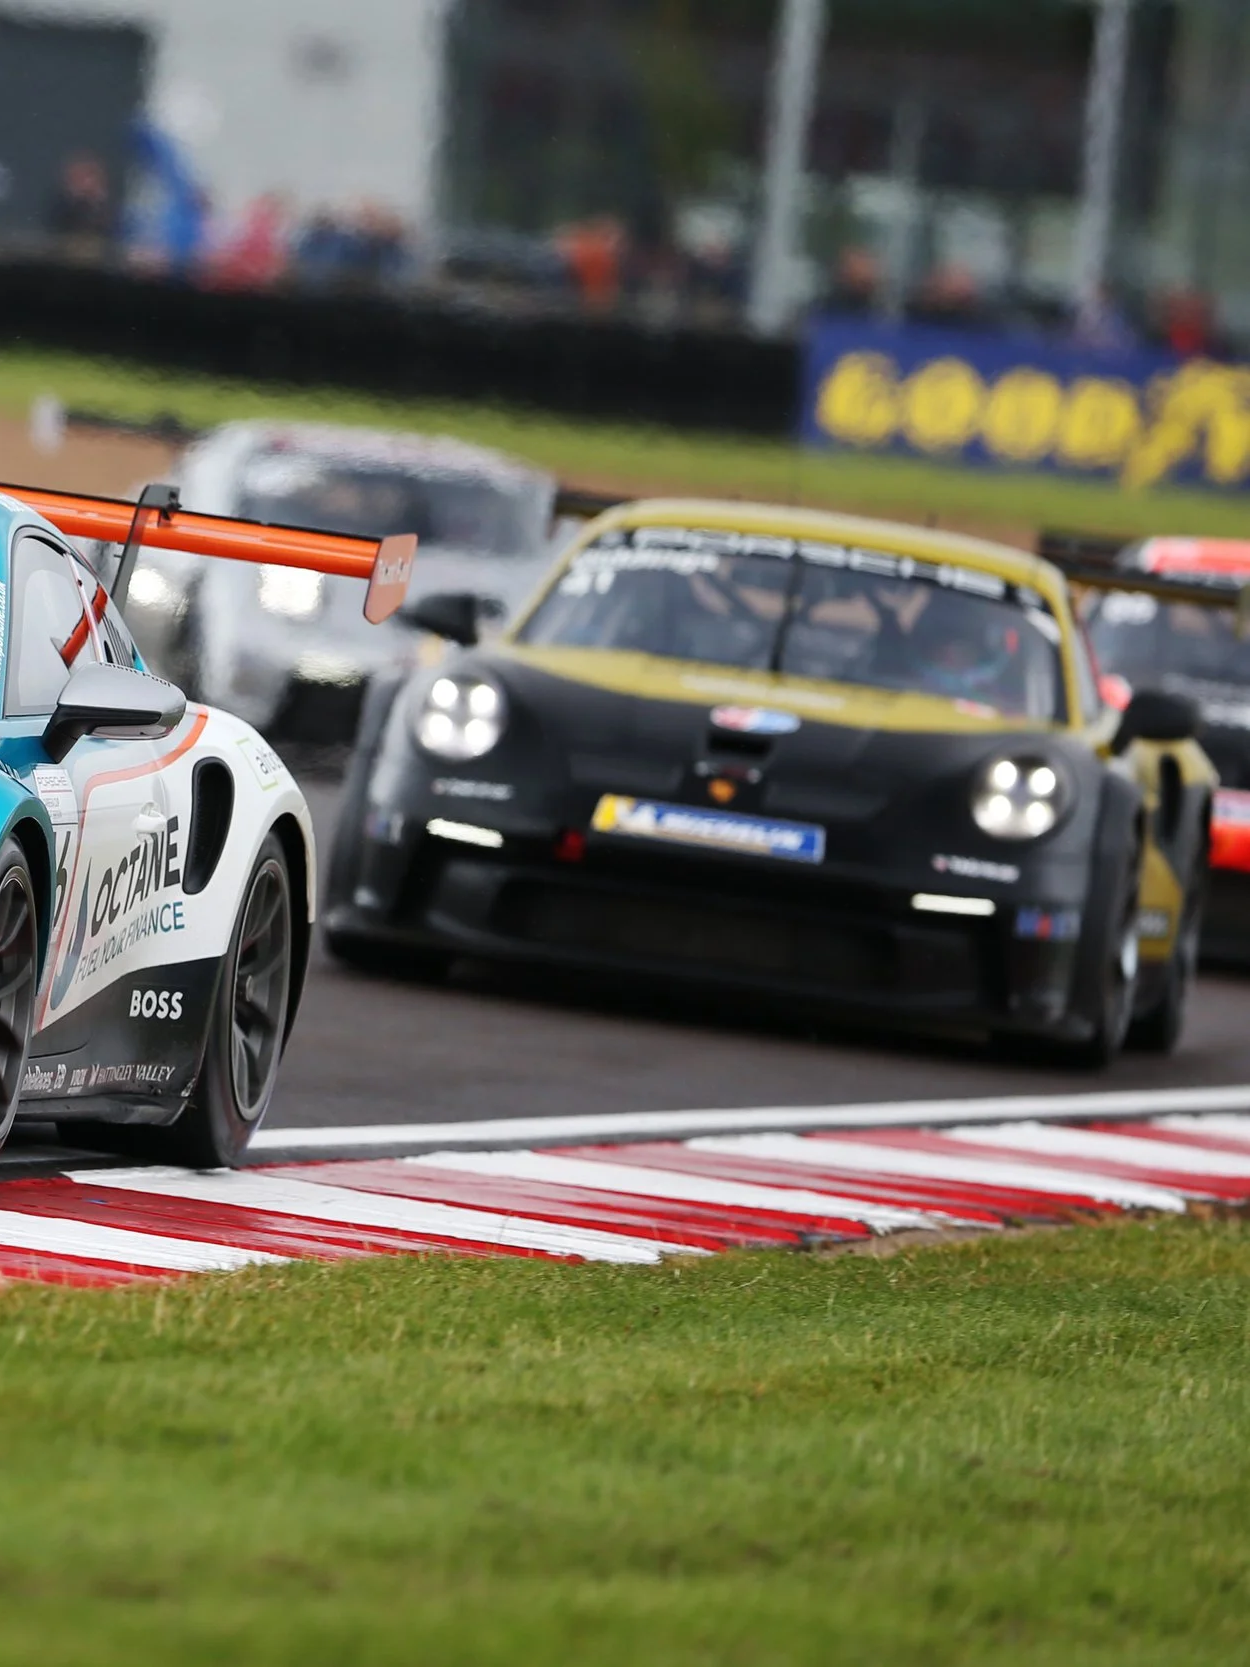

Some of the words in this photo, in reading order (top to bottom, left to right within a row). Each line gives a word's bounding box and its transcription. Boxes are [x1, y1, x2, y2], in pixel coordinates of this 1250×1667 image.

[91, 815, 181, 938] OCTANE
[75, 950, 98, 984] FUEL
[100, 926, 128, 966] YOUR
[126, 901, 186, 949] FINANCE
[129, 988, 184, 1020] BOSS
[136, 1063, 176, 1083] VALLEY
